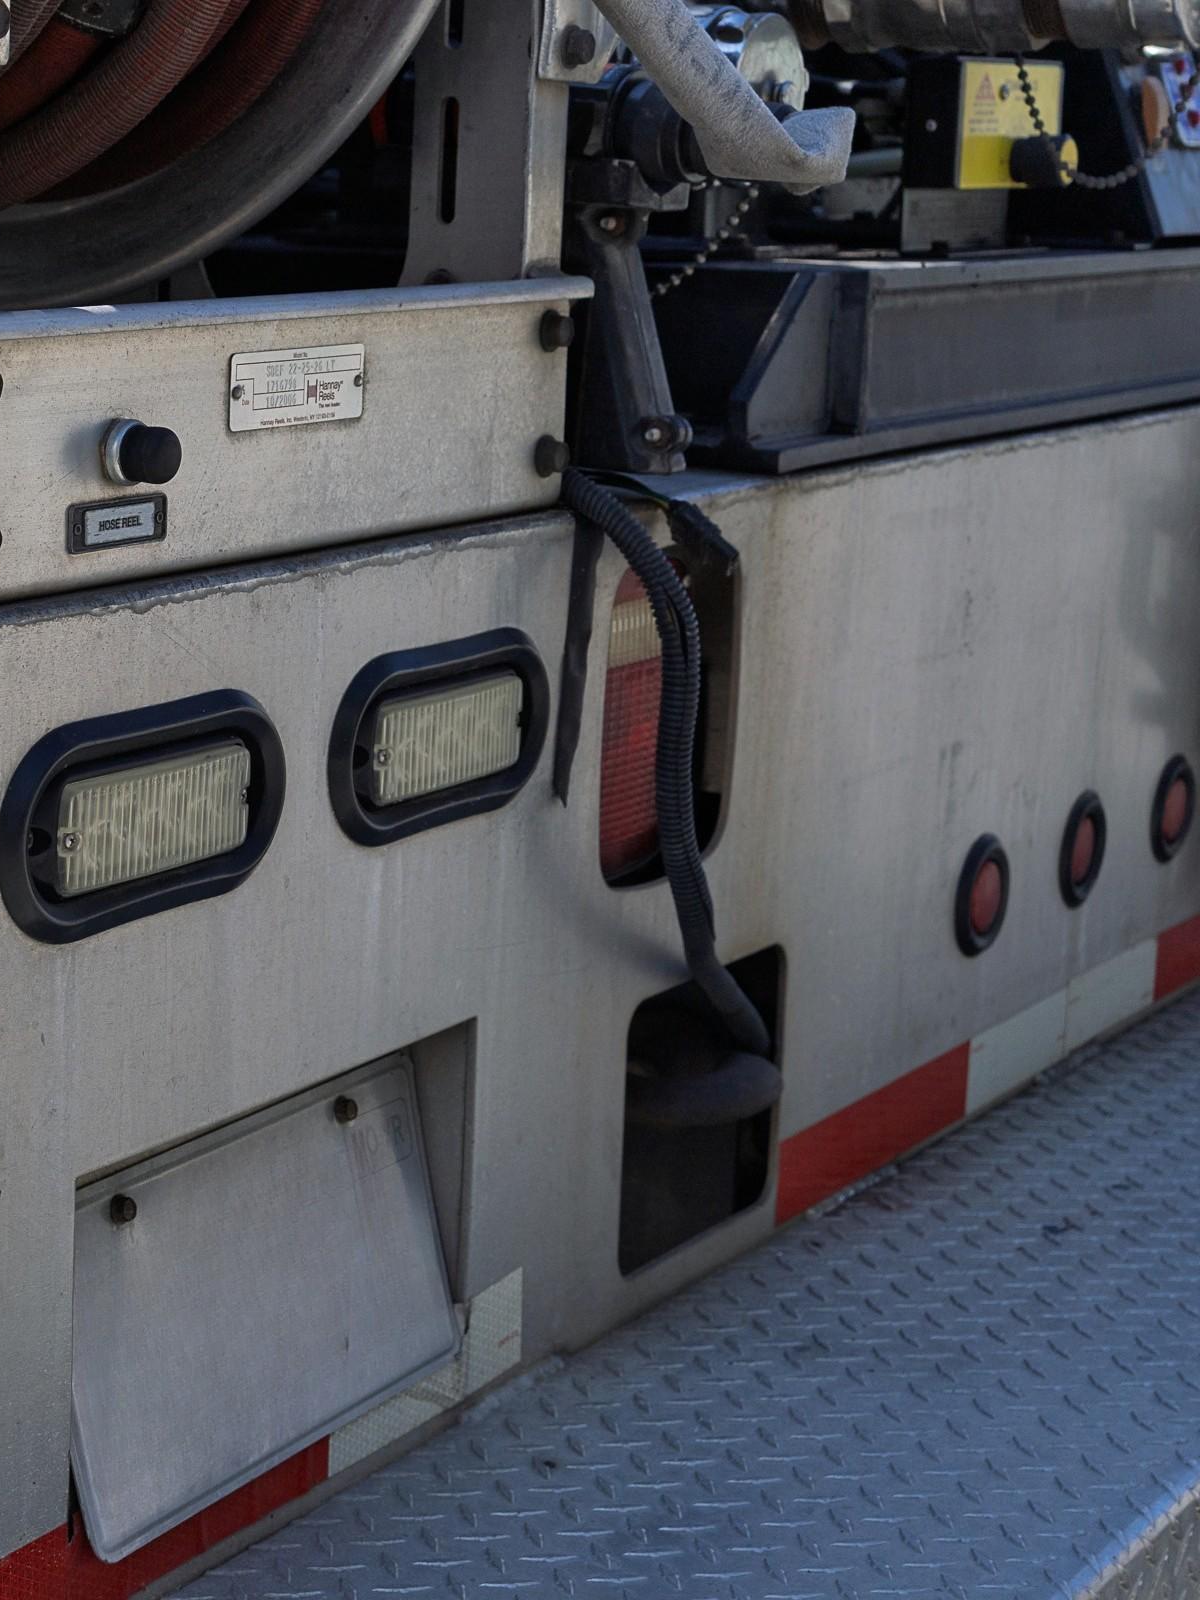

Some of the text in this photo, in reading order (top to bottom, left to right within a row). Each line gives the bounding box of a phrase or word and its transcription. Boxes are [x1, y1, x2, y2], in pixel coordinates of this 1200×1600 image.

[319, 391, 335, 401] Reels
[99, 515, 142, 532] HOSE REEL
